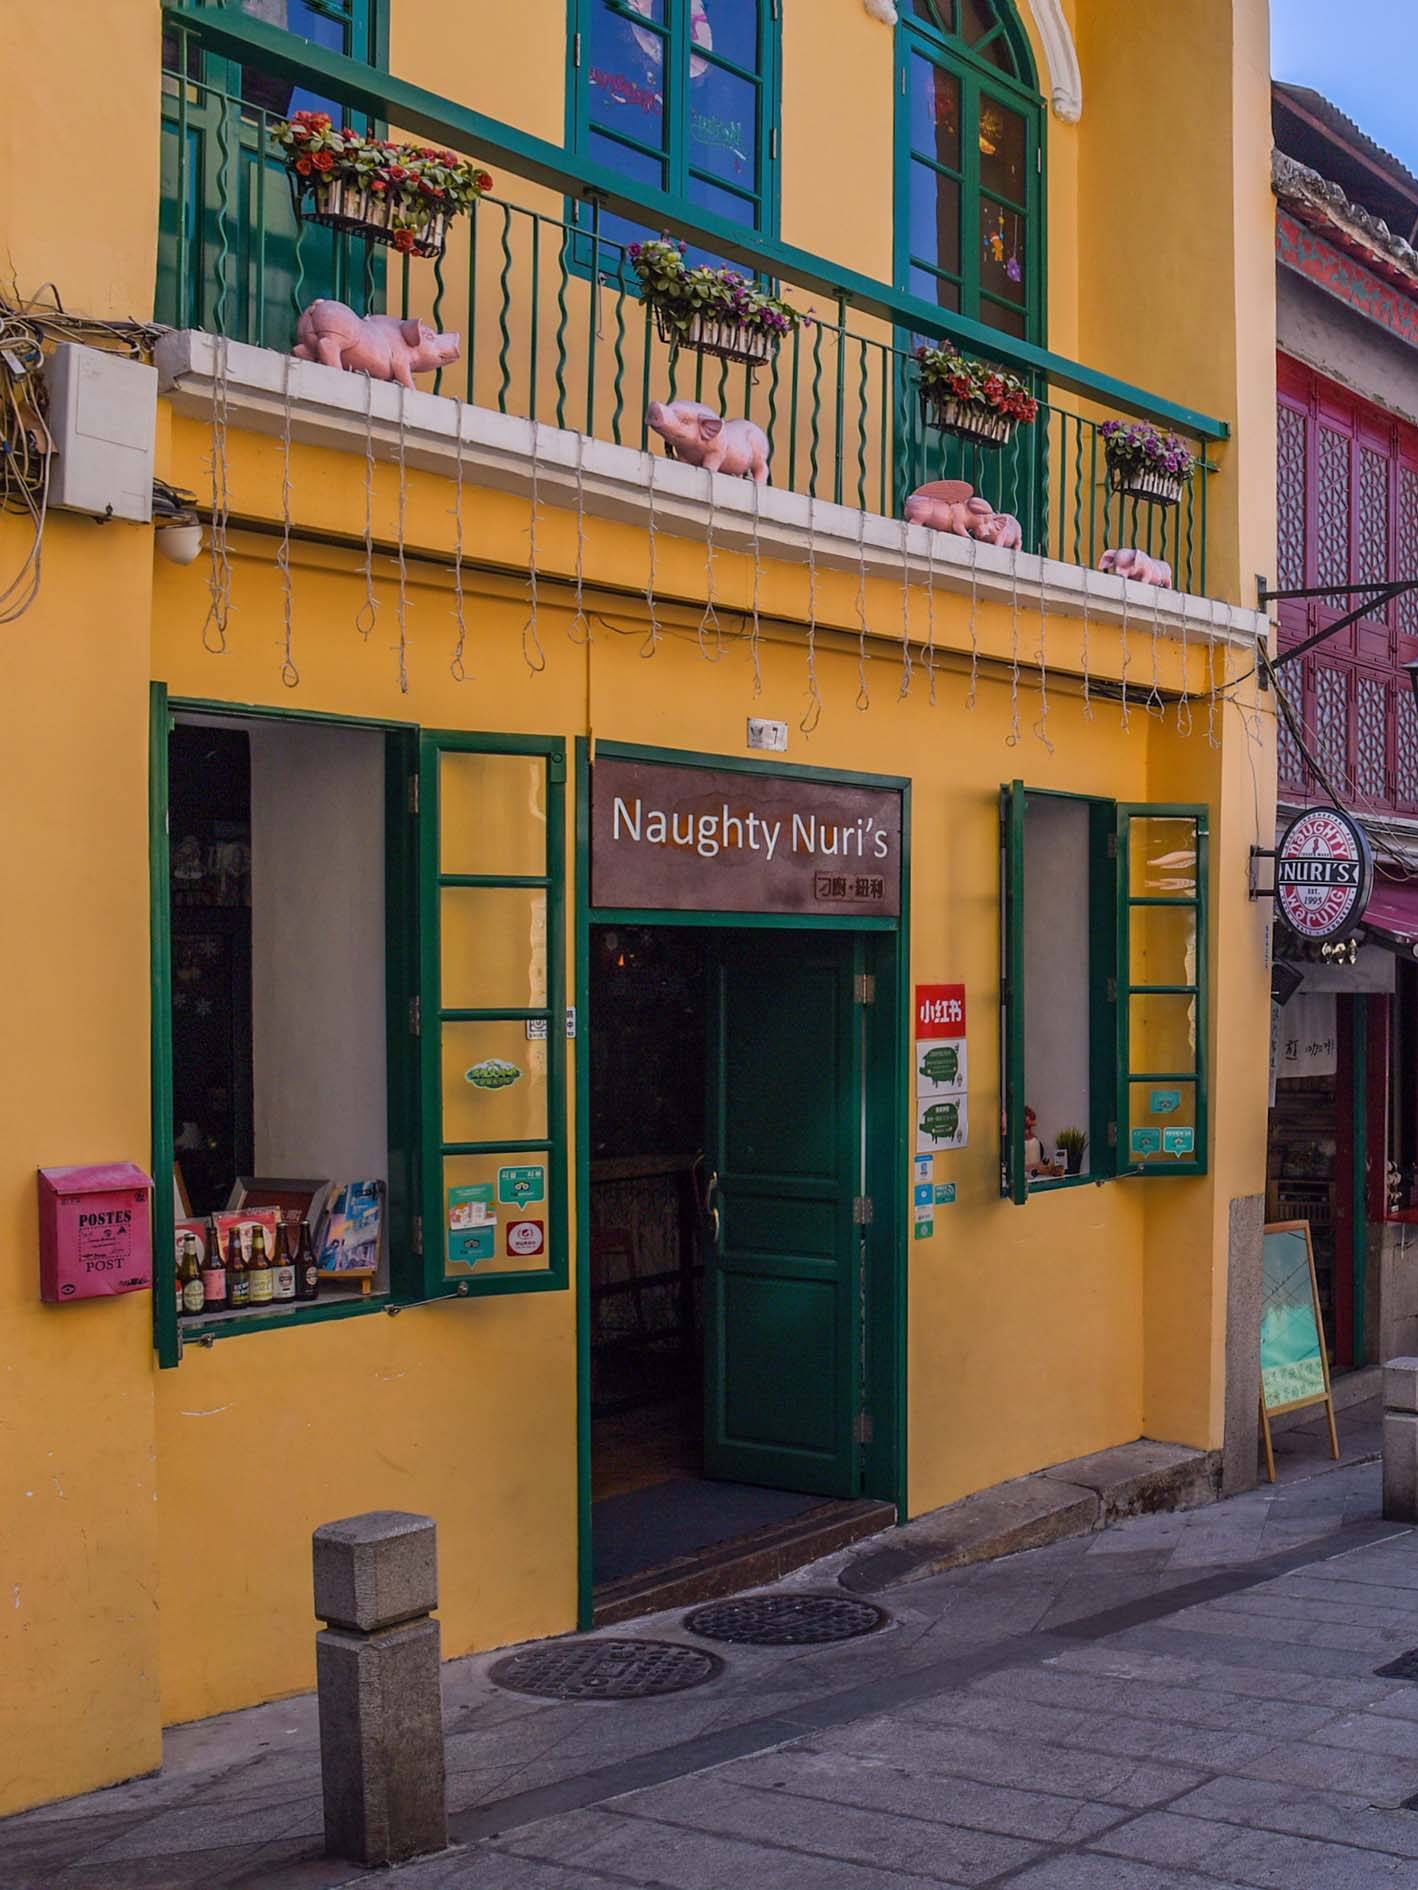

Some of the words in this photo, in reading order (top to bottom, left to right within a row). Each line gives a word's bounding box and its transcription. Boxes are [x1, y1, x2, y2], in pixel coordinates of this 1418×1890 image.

[613, 797, 781, 861] Naughty
[791, 814, 889, 858] Nuri's
[1284, 862, 1350, 882] NURI'S
[920, 999, 962, 1024] 小红书
[79, 1210, 132, 1228] POSTES
[85, 1258, 125, 1273] POST
